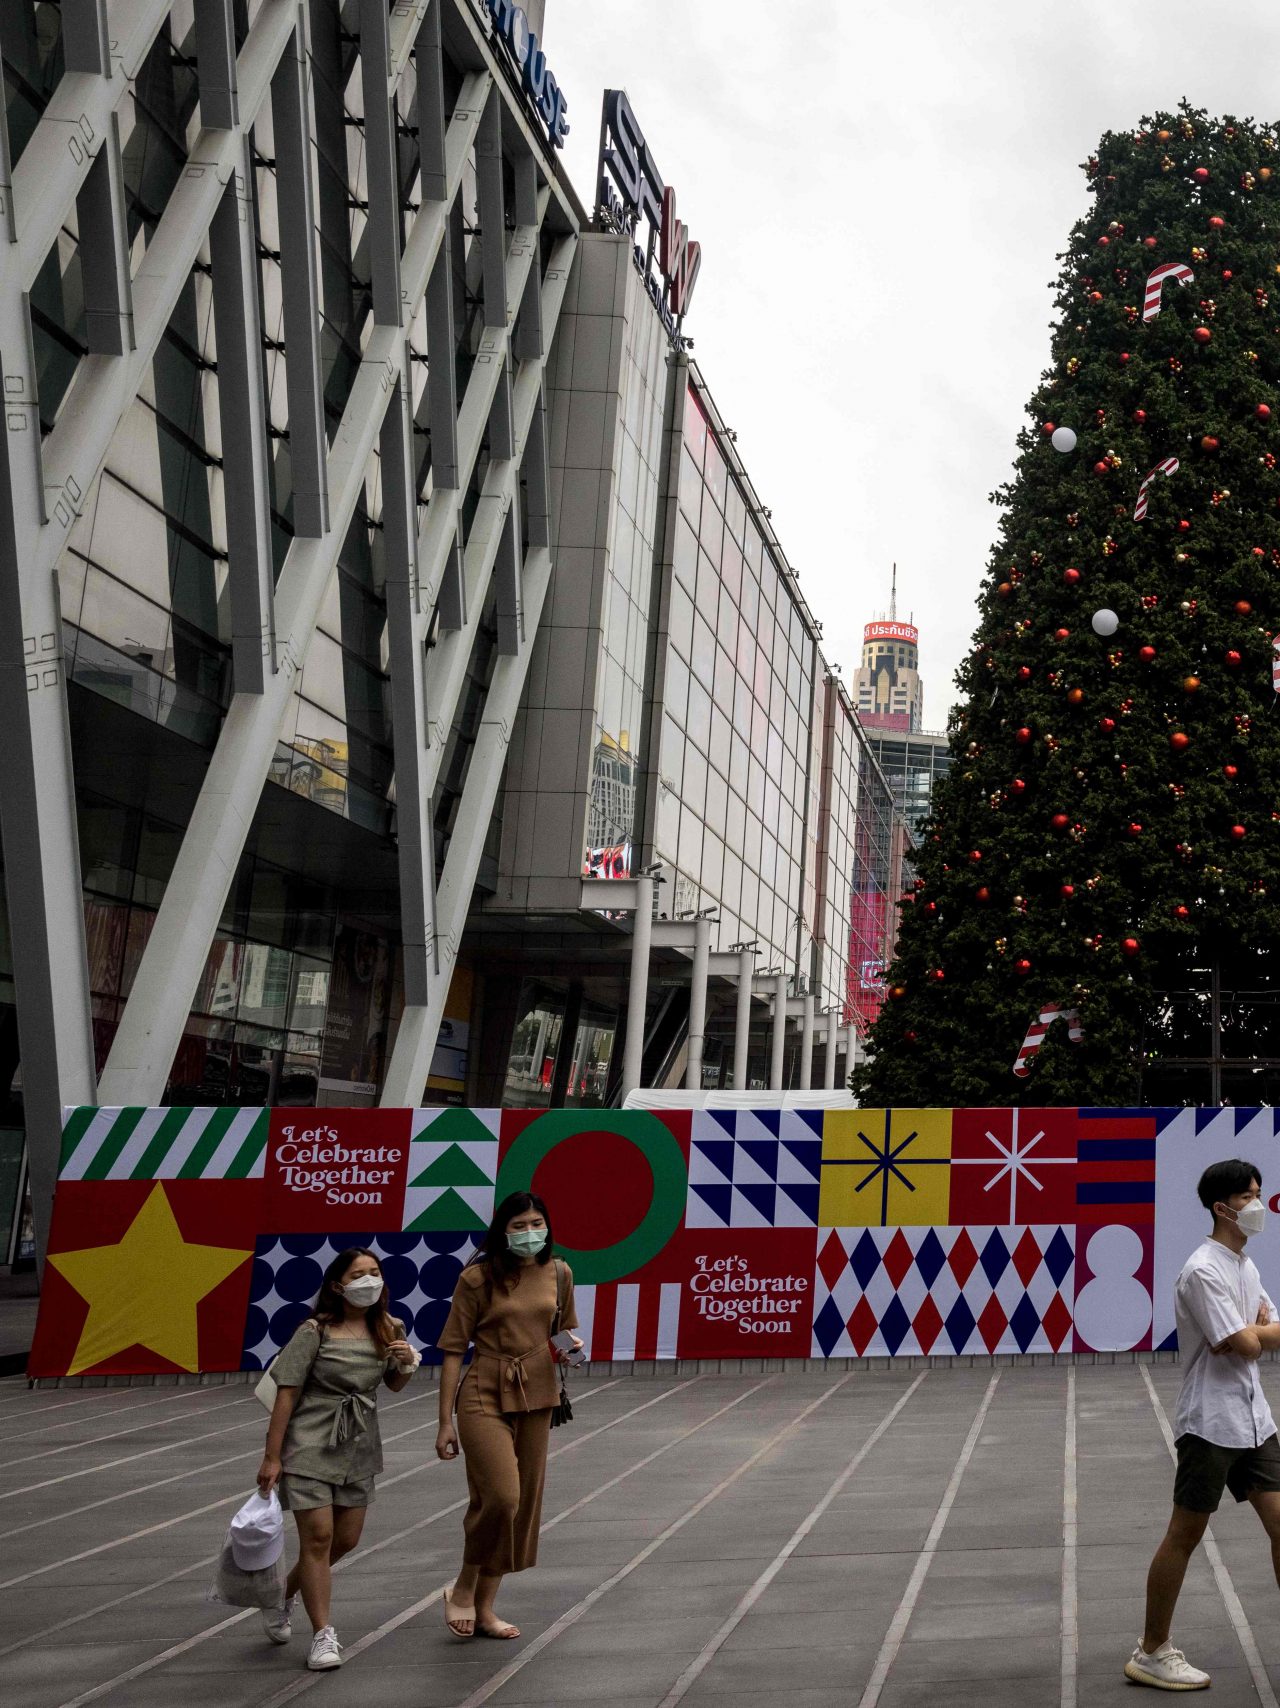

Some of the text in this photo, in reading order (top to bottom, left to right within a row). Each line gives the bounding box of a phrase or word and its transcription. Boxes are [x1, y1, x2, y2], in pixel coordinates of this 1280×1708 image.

[282, 1125, 338, 1143] Let's
[275, 1143, 402, 1164] Celebrate
[278, 1165, 395, 1192] Together
[325, 1187, 383, 1205] Soon
[694, 1254, 748, 1272] Let's
[689, 1272, 808, 1293] Celebrate
[693, 1294, 802, 1321] Together
[738, 1316, 792, 1334] Soon
